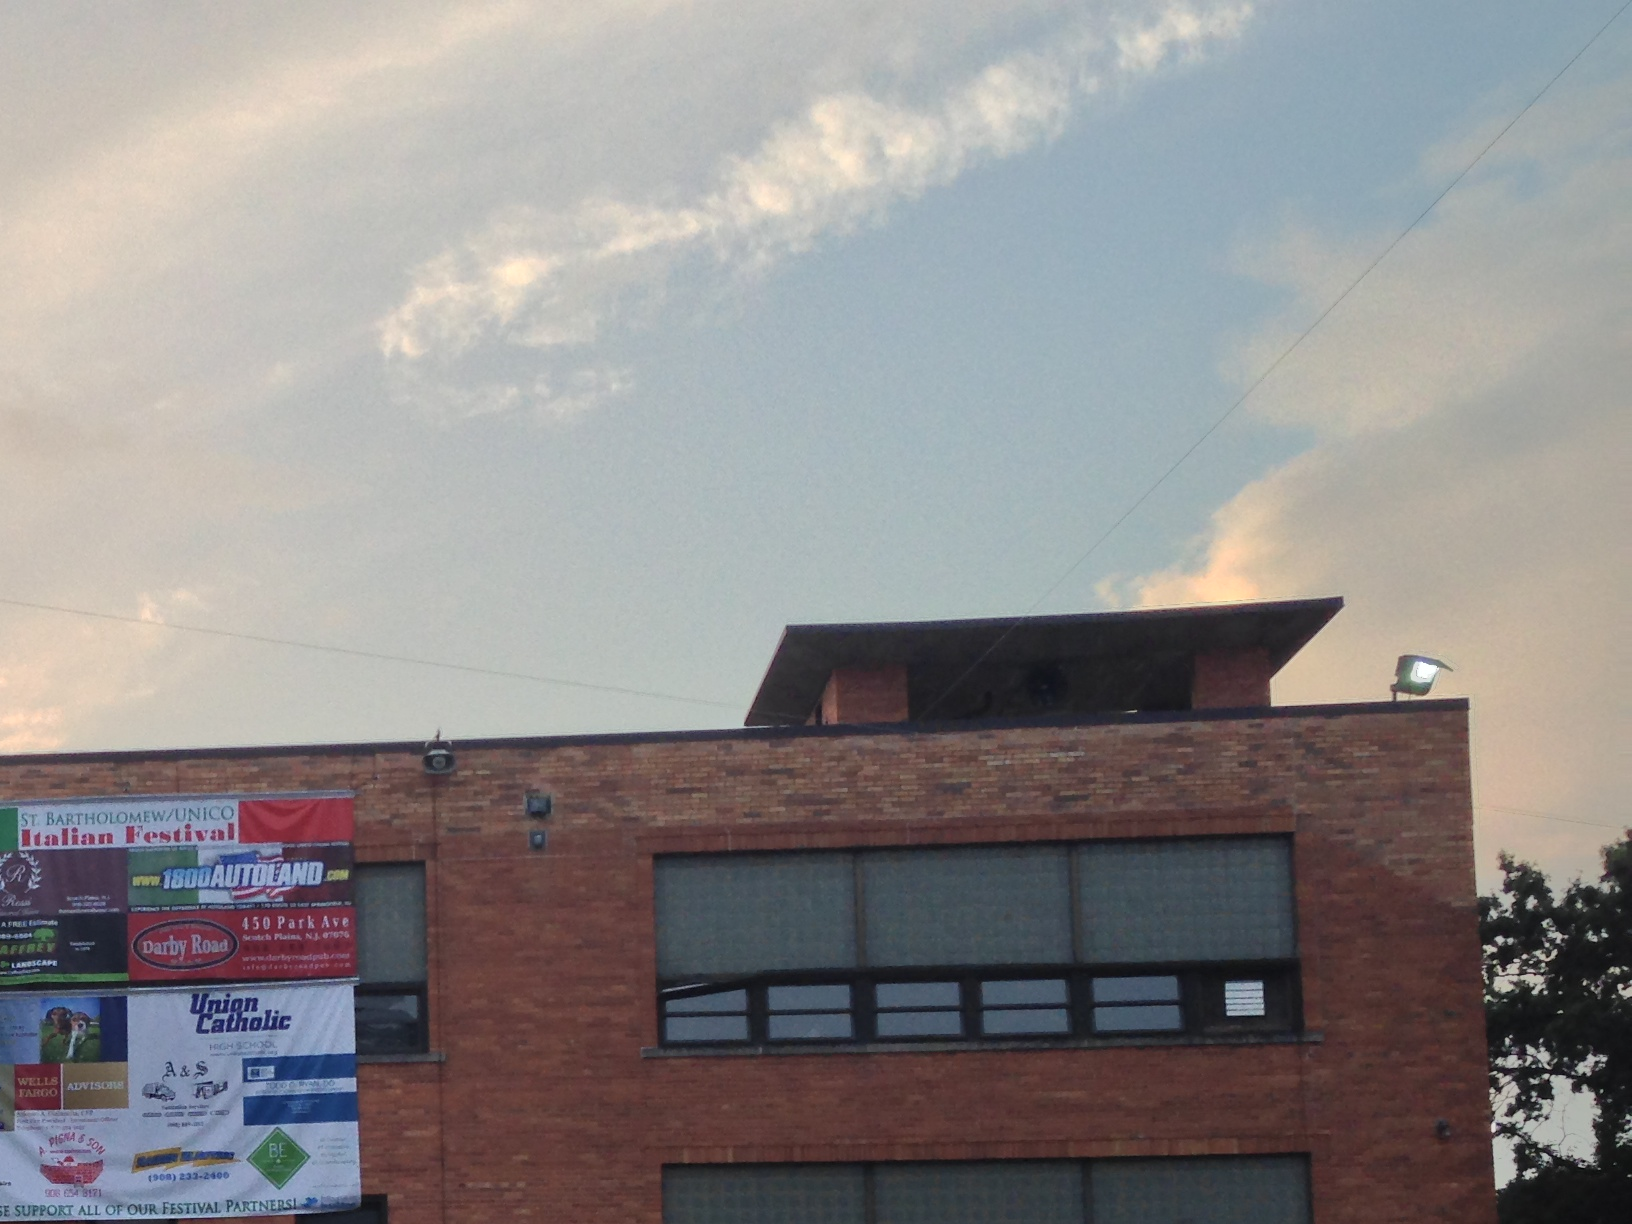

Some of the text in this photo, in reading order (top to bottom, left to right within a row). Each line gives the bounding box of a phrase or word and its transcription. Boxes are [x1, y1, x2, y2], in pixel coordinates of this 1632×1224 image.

[46, 805, 235, 827] BARTHOLOMEW/UNICO
[21, 822, 236, 847] Italian Festival
[241, 915, 350, 931] 450 Park Ave
[142, 934, 228, 962] Darby Road
[11, 960, 58, 969] LANDSCAPE
[189, 992, 259, 1015] Union
[195, 1009, 292, 1034] Catholic
[161, 1060, 210, 1081] A & S
[17, 1077, 59, 1087] WELLS
[67, 1080, 125, 1091] ADVISORS
[17, 1088, 59, 1098] FARGO
[86, 1136, 106, 1157] SON
[268, 1142, 288, 1158] BE
[15, 1203, 75, 1217] SUPPORT
[77, 1203, 102, 1216] ALL
[105, 1202, 124, 1216] OF
[127, 1202, 159, 1216] OUR
[161, 1201, 221, 1215] FESTIVAL
[225, 1197, 297, 1213] PARTNERS!
